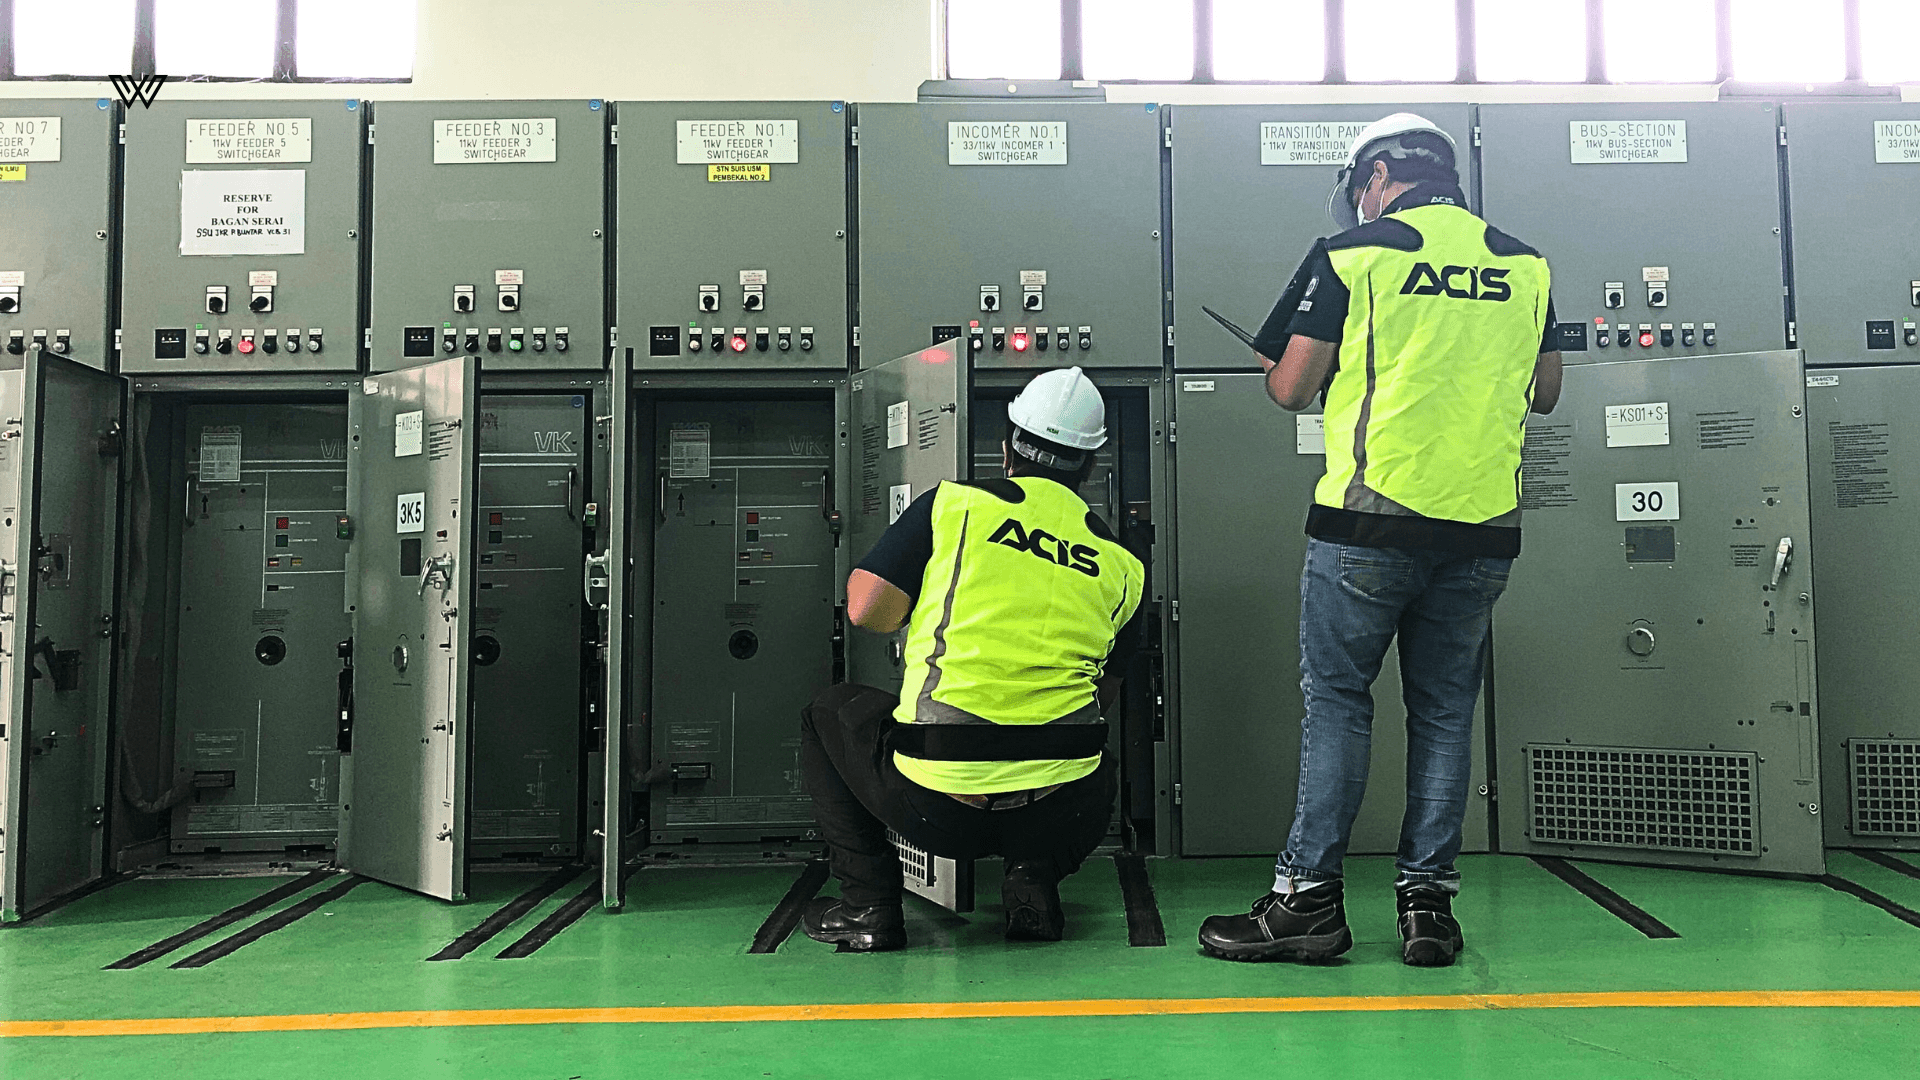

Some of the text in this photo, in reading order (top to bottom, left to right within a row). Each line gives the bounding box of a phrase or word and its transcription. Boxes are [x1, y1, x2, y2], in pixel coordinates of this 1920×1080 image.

[199, 123, 255, 136] FEEDER
[446, 123, 501, 136] FEEDER
[690, 123, 745, 136] FEEDER
[957, 125, 1020, 138] INCOMER
[1264, 125, 1330, 138] TRANSITION
[1580, 124, 1676, 137] BUS-SECTION
[212, 138, 286, 148] 11kV FEEDER 5
[459, 138, 532, 148] 11kV FEEDER 3
[703, 139, 773, 148] 11kV FEEDER 1
[963, 141, 1053, 150] 33/11kV INCOMER 1
[1269, 141, 1346, 150] 11kV TRANSITION
[1585, 139, 1672, 148] 11kV BUS-SECTION
[217, 149, 281, 159] SWITCHGEAR
[464, 149, 526, 159] SWITCHGEAR
[706, 150, 769, 159] SWITCHGEAR
[977, 151, 1038, 161] SWITCHGEAR
[1599, 149, 1659, 159] SWITCHGEAR
[223, 194, 273, 202] RESERVE
[237, 206, 259, 214] FOR
[211, 217, 284, 226] BAGAN SERAI
[196, 228, 213, 238] SSU
[1399, 262, 1512, 302] ACIS
[534, 431, 572, 452] VK
[788, 435, 823, 455] VK
[1632, 491, 1663, 512] 30
[400, 501, 422, 525] 3K5
[986, 518, 1100, 577] ACIS
